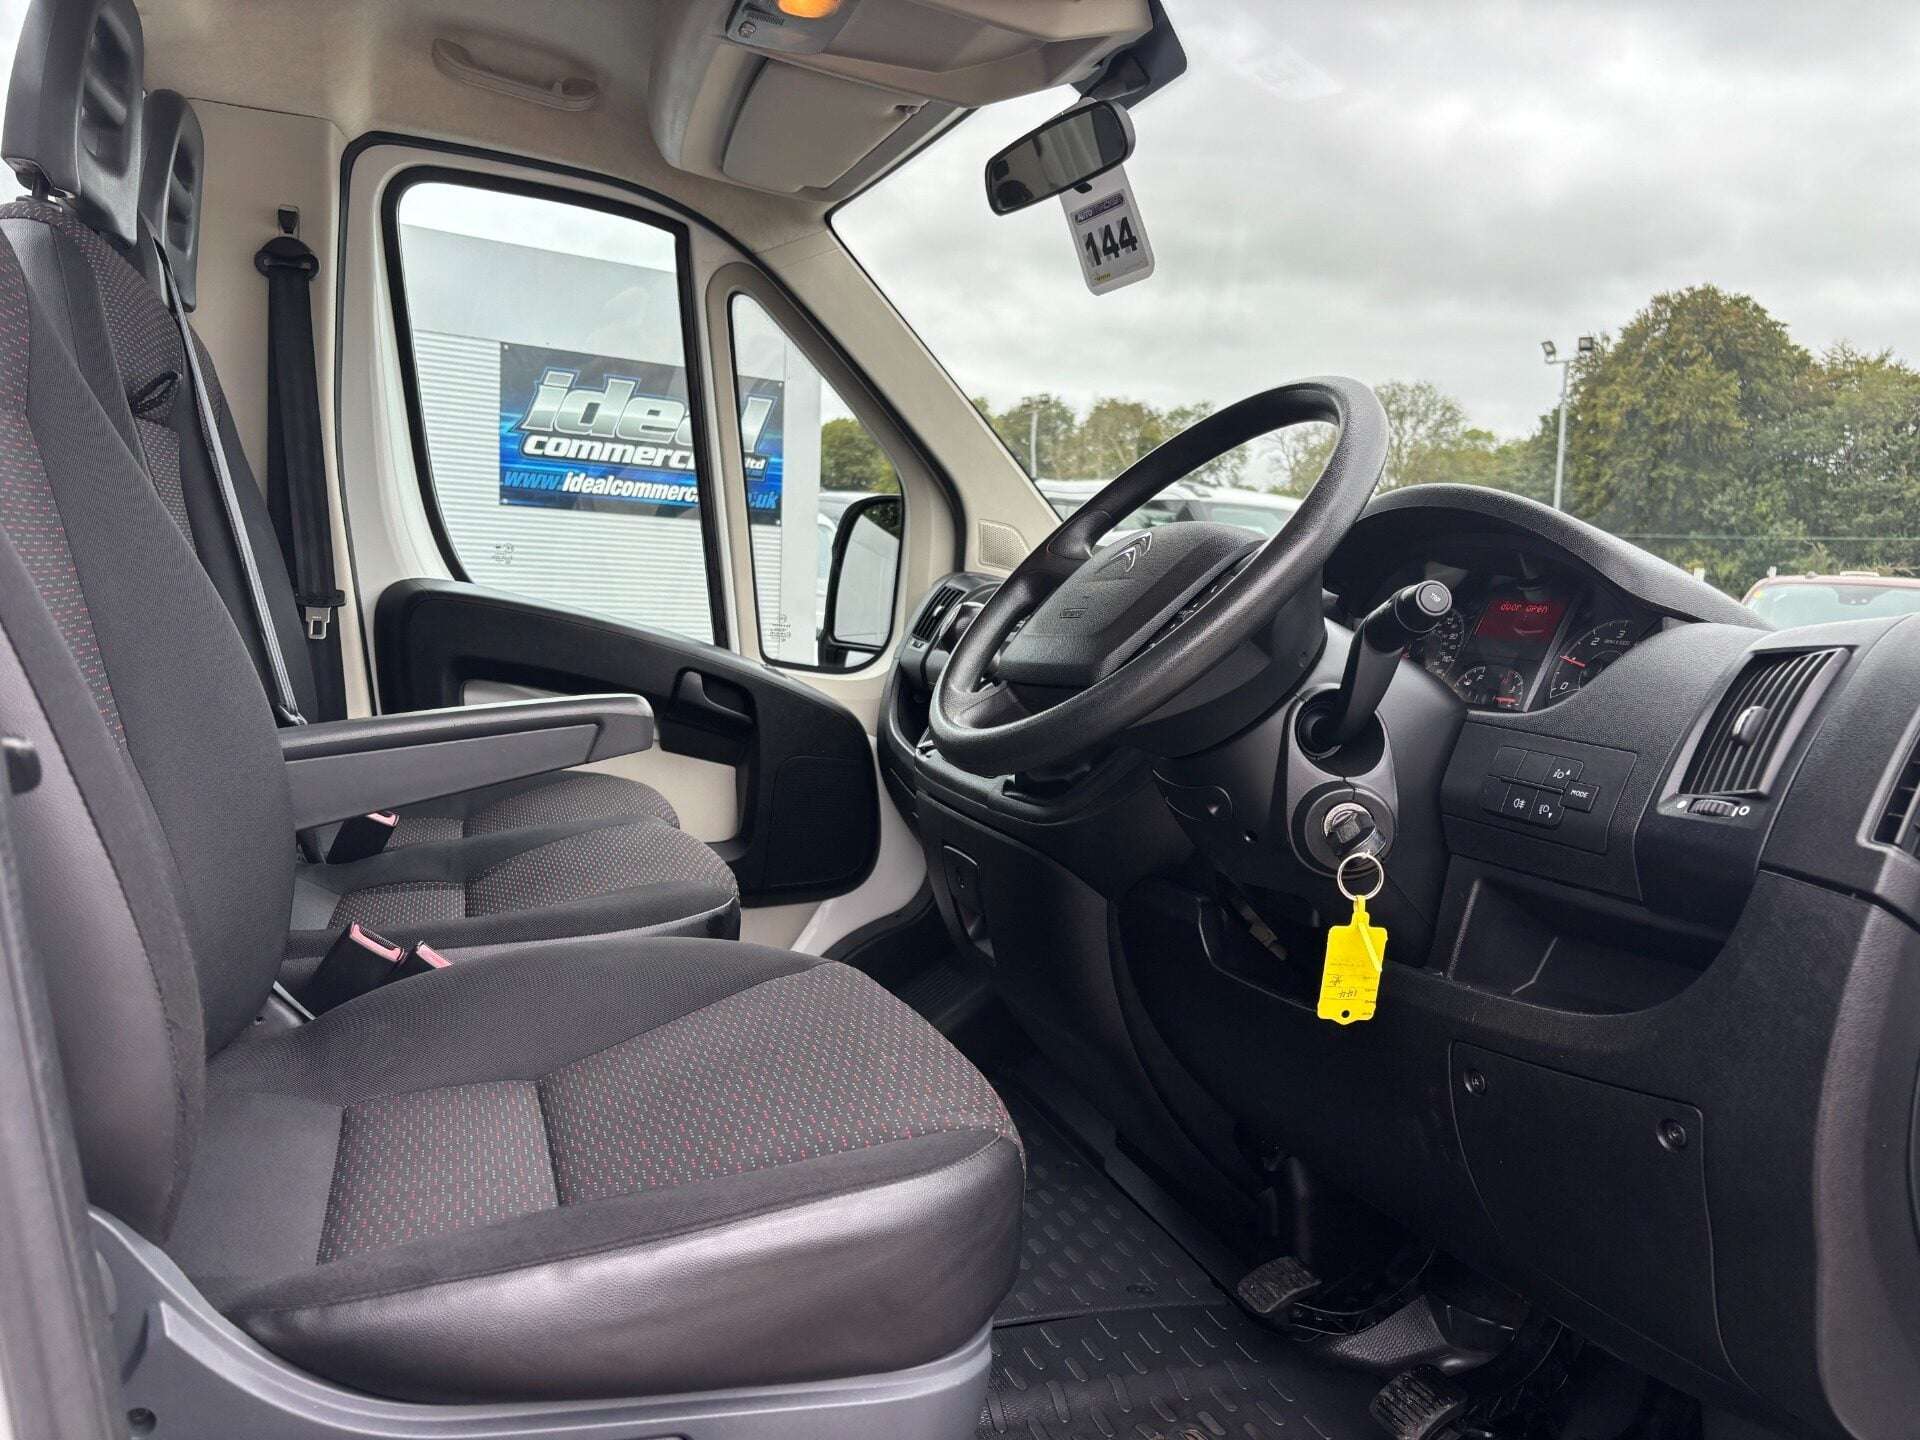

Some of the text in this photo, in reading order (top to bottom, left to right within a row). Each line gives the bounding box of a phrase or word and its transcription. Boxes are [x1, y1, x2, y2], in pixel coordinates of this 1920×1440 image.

[1085, 216, 1138, 266] 144
[1590, 637, 1601, 646] 2
[1570, 789, 1590, 799] MODE
